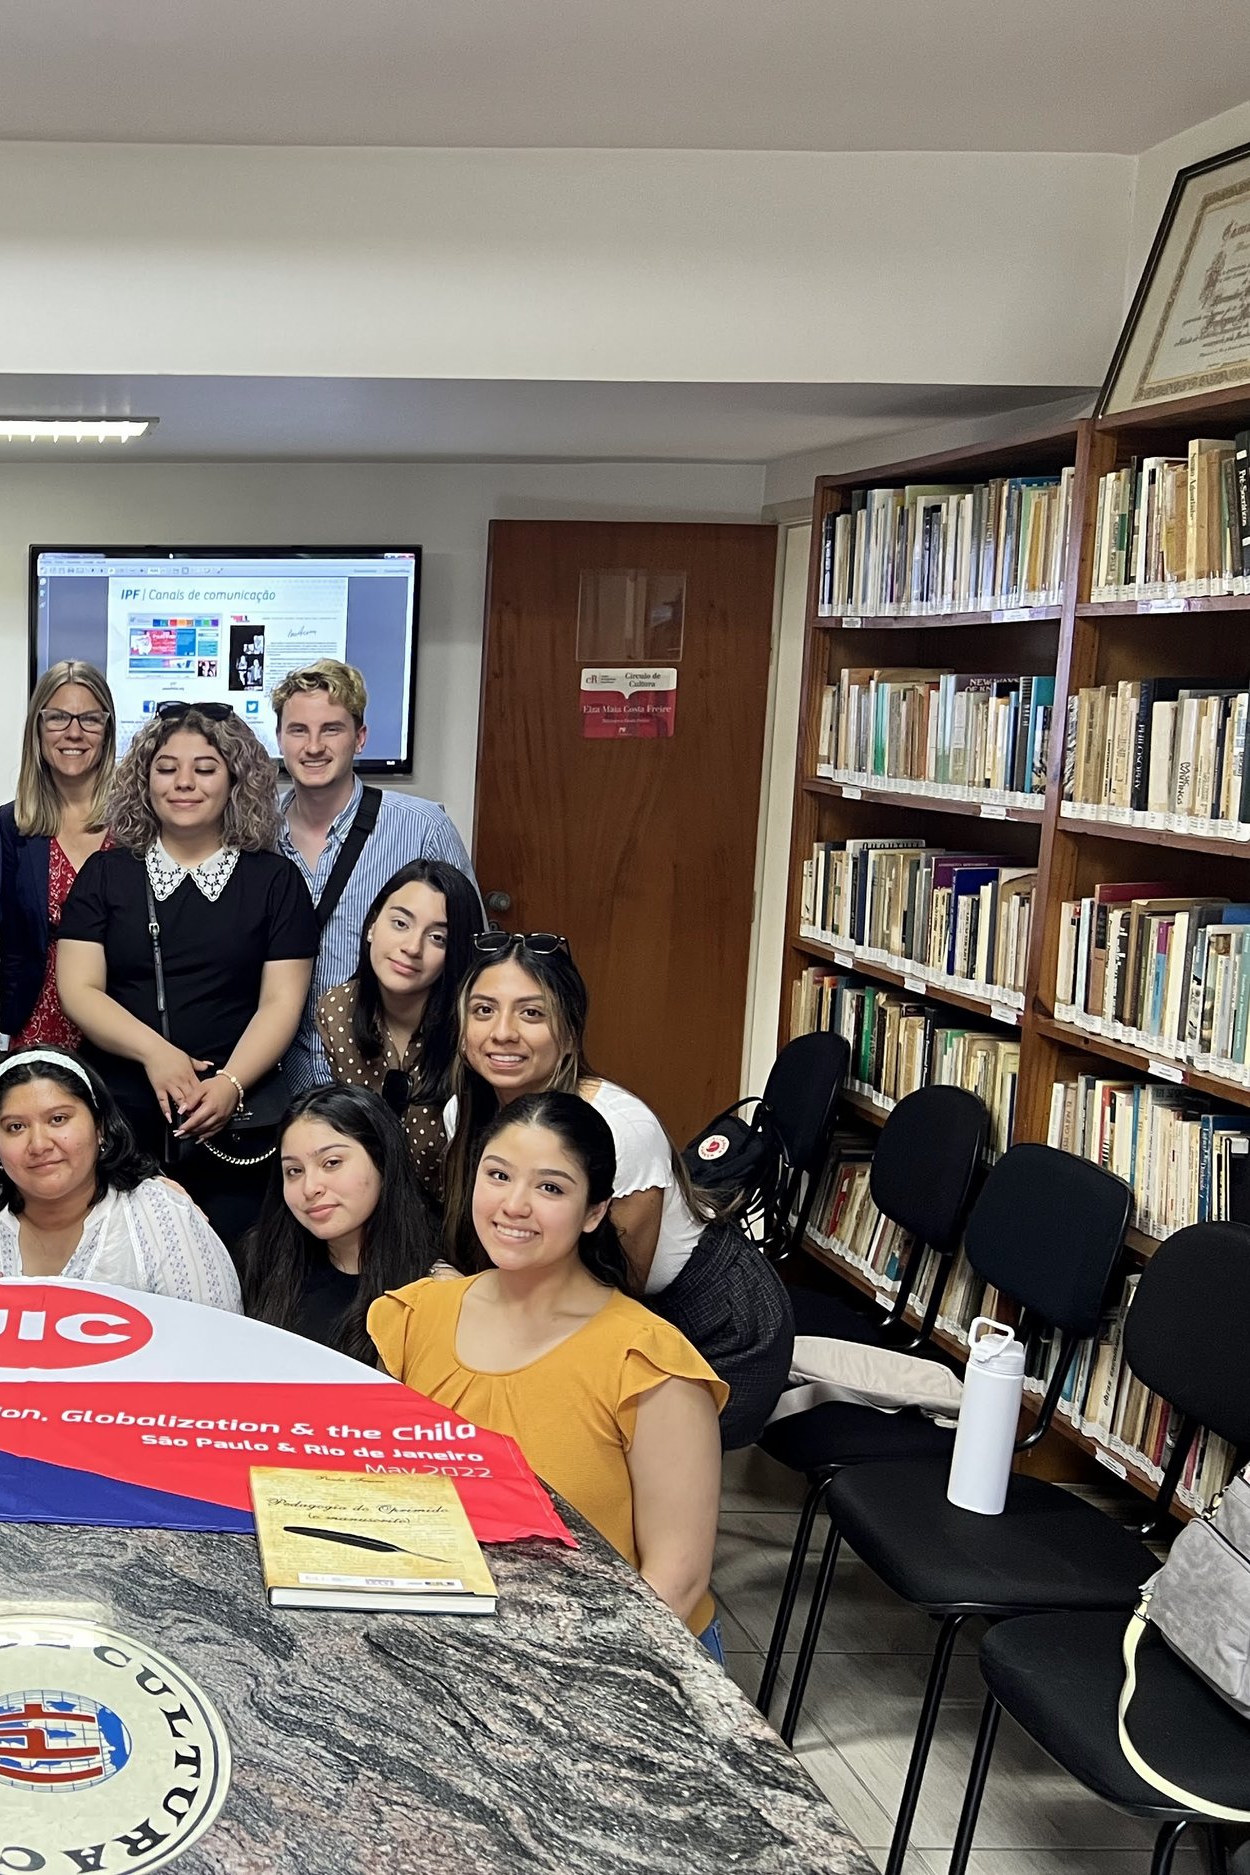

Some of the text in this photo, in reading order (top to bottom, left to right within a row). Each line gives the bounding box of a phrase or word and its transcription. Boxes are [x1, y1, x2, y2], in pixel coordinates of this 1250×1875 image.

[121, 589, 276, 603] IPF Canais de comunicação
[60, 1409, 281, 1435] Globalization
[290, 1423, 315, 1437] &
[326, 1424, 382, 1440] the
[140, 1434, 484, 1462] São Paulo & Rio de Janeiro
[422, 1464, 495, 1479] 2022
[61, 1644, 203, 1875] CULTURA
